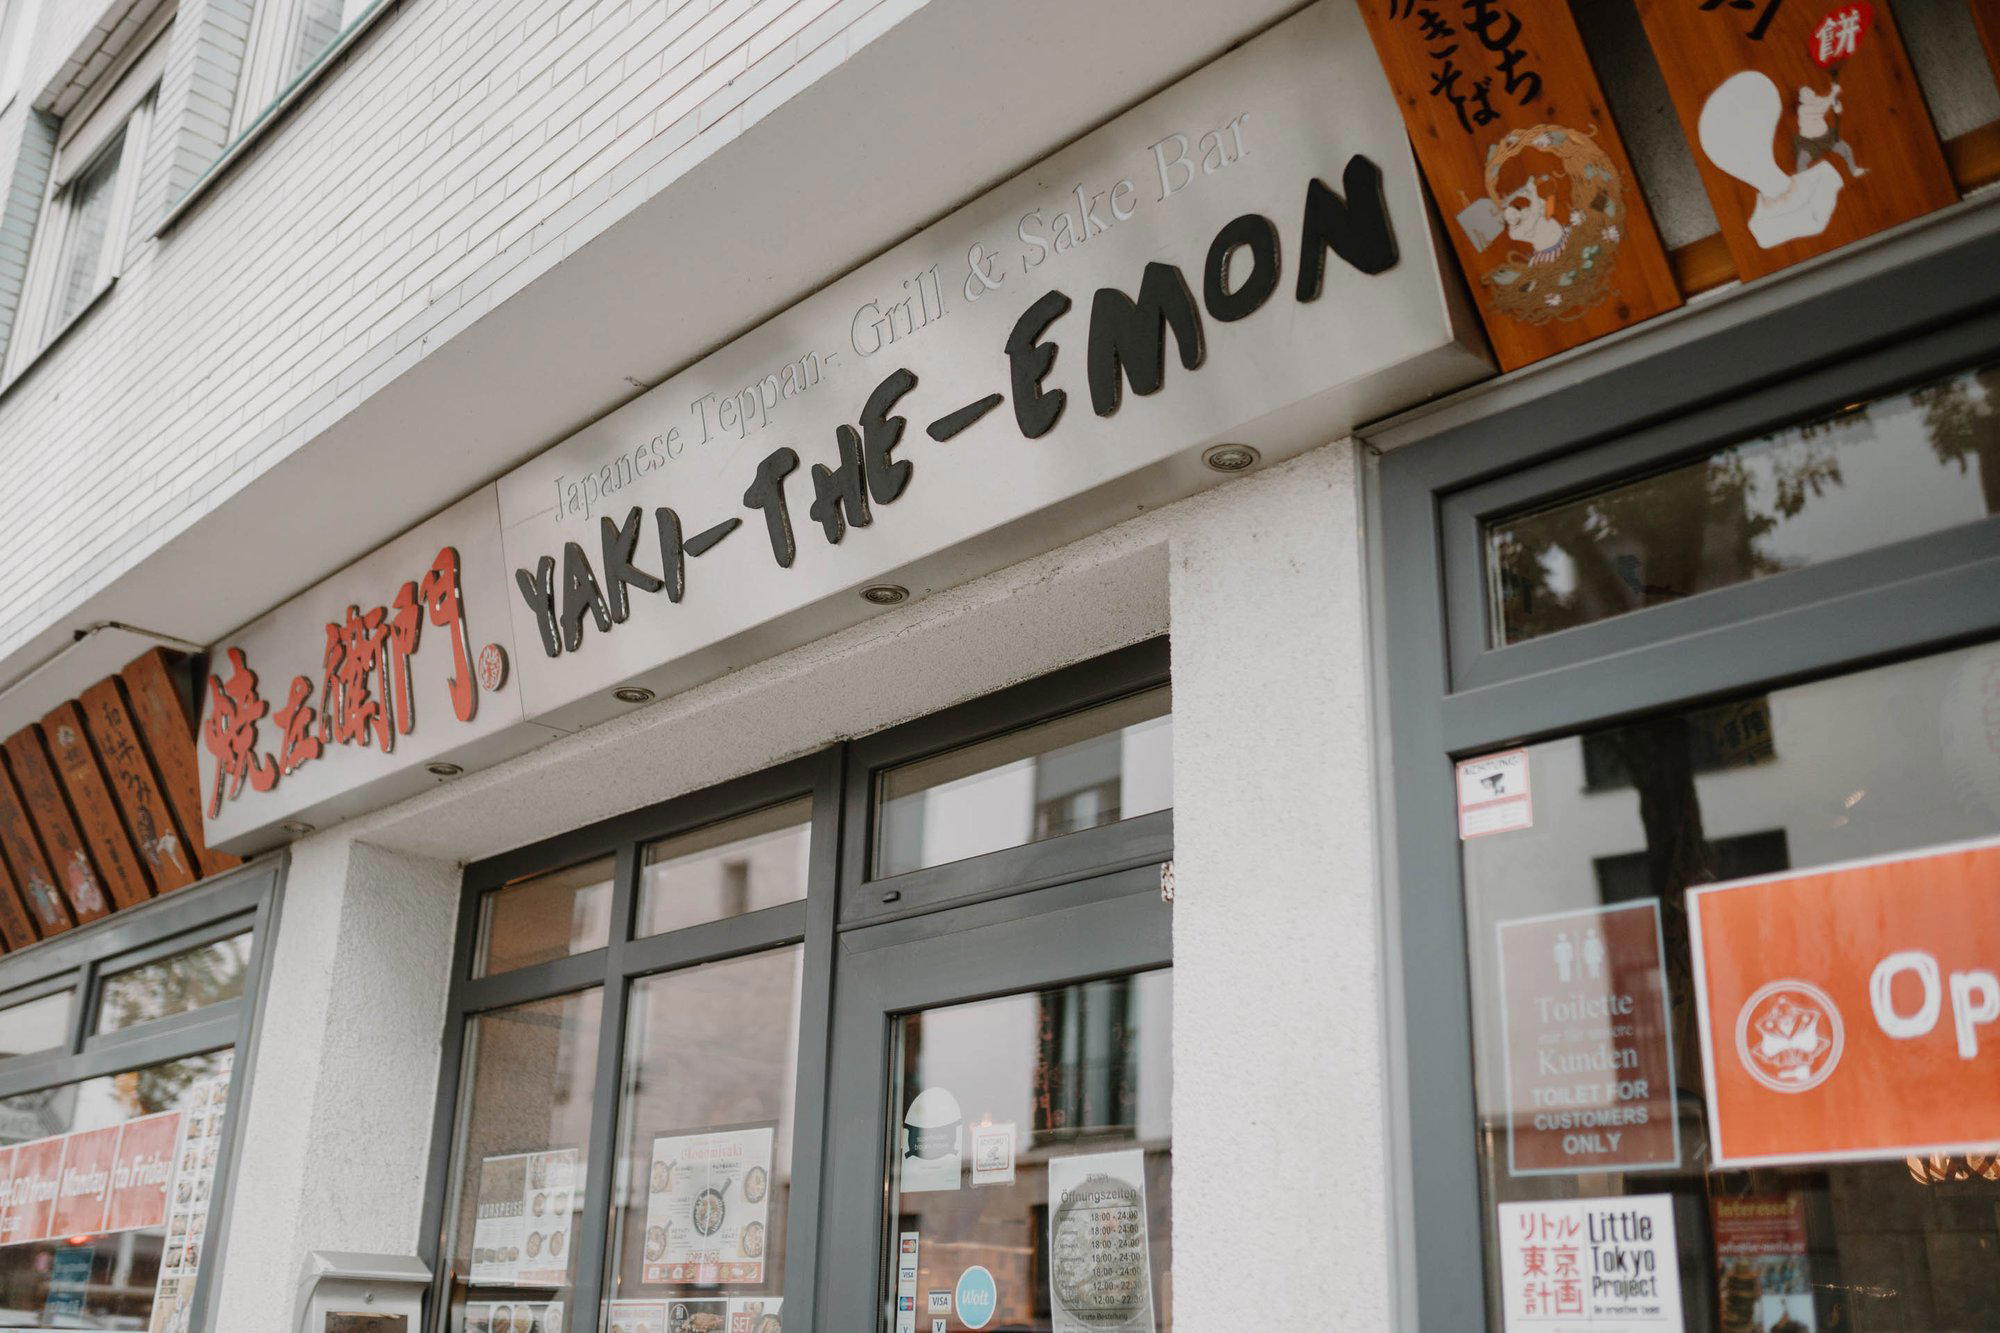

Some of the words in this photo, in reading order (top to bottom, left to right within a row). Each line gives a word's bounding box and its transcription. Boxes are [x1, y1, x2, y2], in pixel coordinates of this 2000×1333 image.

[1815, 8, 1861, 62] 餅
[554, 423, 684, 524] Japanese
[850, 264, 950, 358] Grill
[963, 241, 1006, 303] &
[1017, 178, 1138, 274] Sake
[1147, 110, 1251, 203] Bar
[1534, 991, 1634, 1024] Toilette
[1538, 1042, 1638, 1076] Kunden
[1531, 1085, 1602, 1107] TOILET
[1605, 1080, 1649, 1104] FOR
[1534, 1105, 1649, 1131] CUSTOMERS
[1562, 1132, 1623, 1155] ONLY
[1061, 1187, 1137, 1204] Öffnungszeiten
[1519, 1212, 1581, 1241] リトル
[1588, 1211, 1654, 1243] Little
[902, 1271, 914, 1279] VISA
[1519, 1244, 1580, 1280] 東京
[1590, 1245, 1657, 1278] Tokyo
[931, 1296, 949, 1307] VISA
[961, 1288, 990, 1306] Wolt
[1523, 1277, 1584, 1316] 計画
[1592, 1275, 1659, 1301] Project
